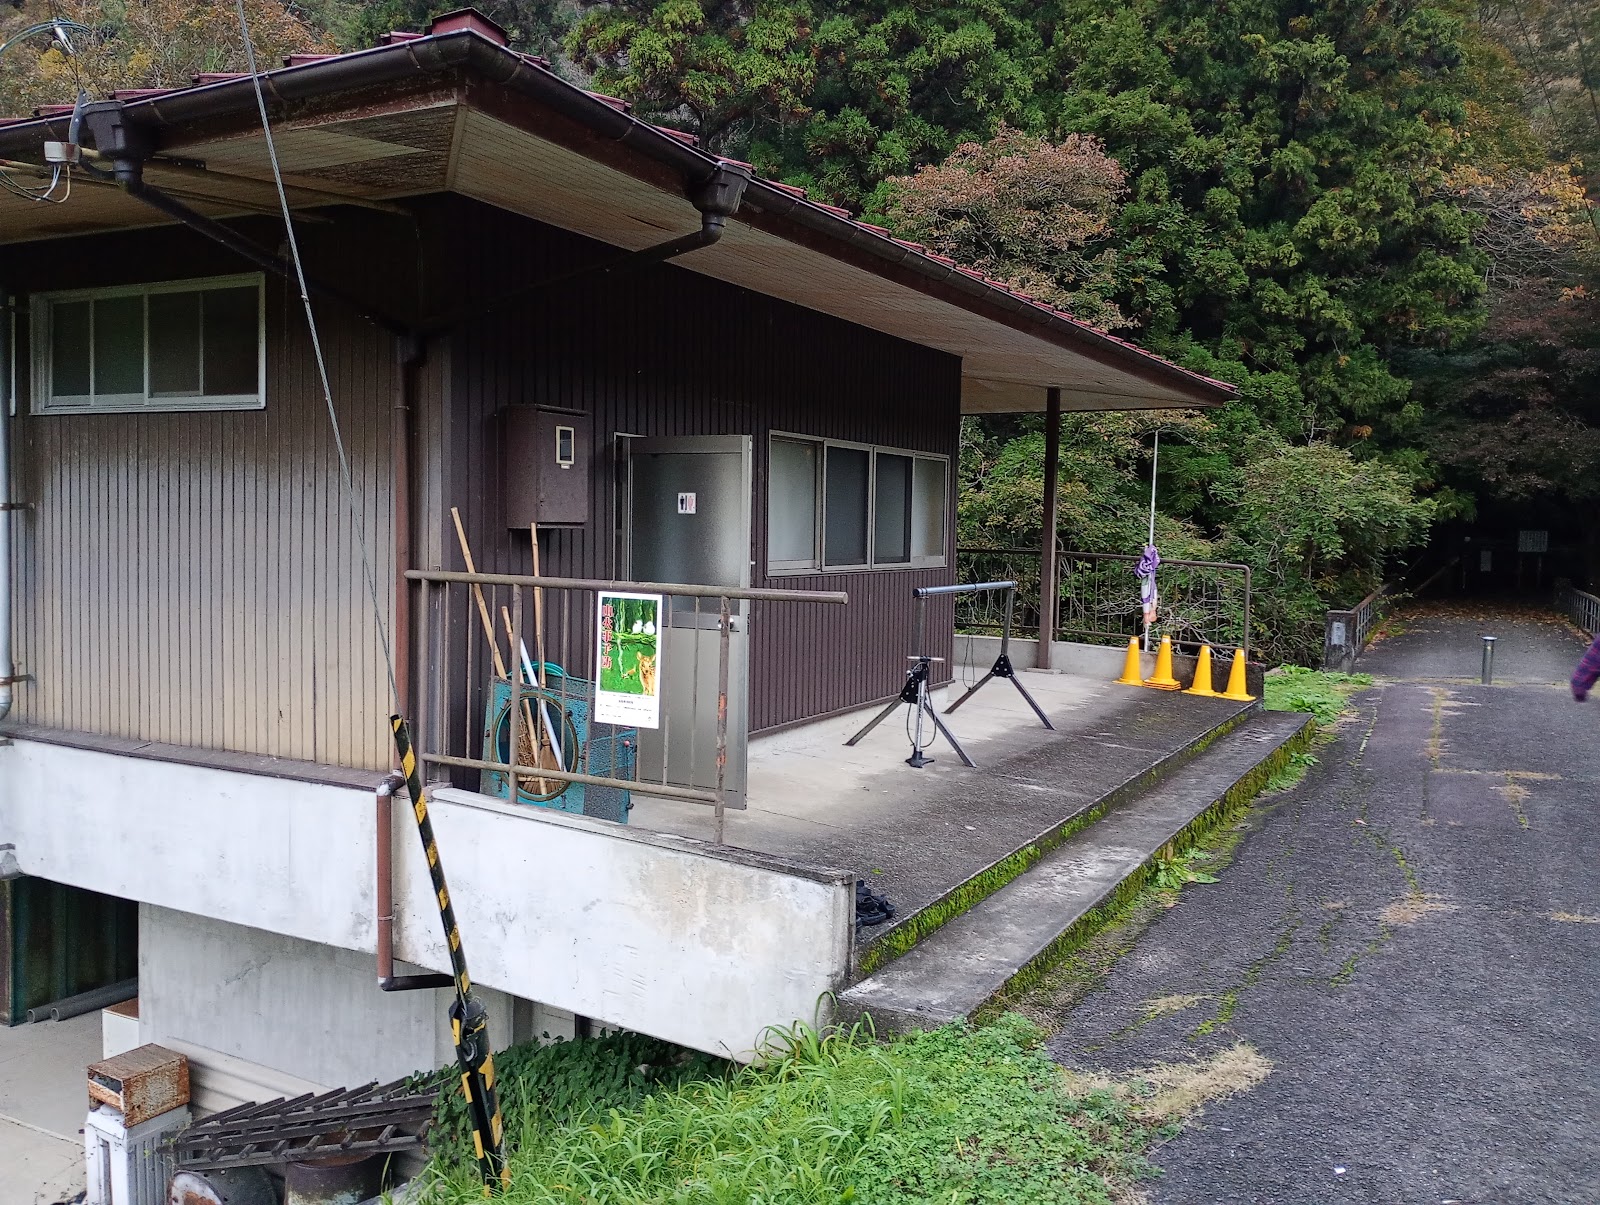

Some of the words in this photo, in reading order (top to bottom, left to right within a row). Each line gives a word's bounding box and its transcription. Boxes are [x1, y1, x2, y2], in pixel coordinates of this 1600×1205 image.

[601, 604, 614, 669] 山火事予防
